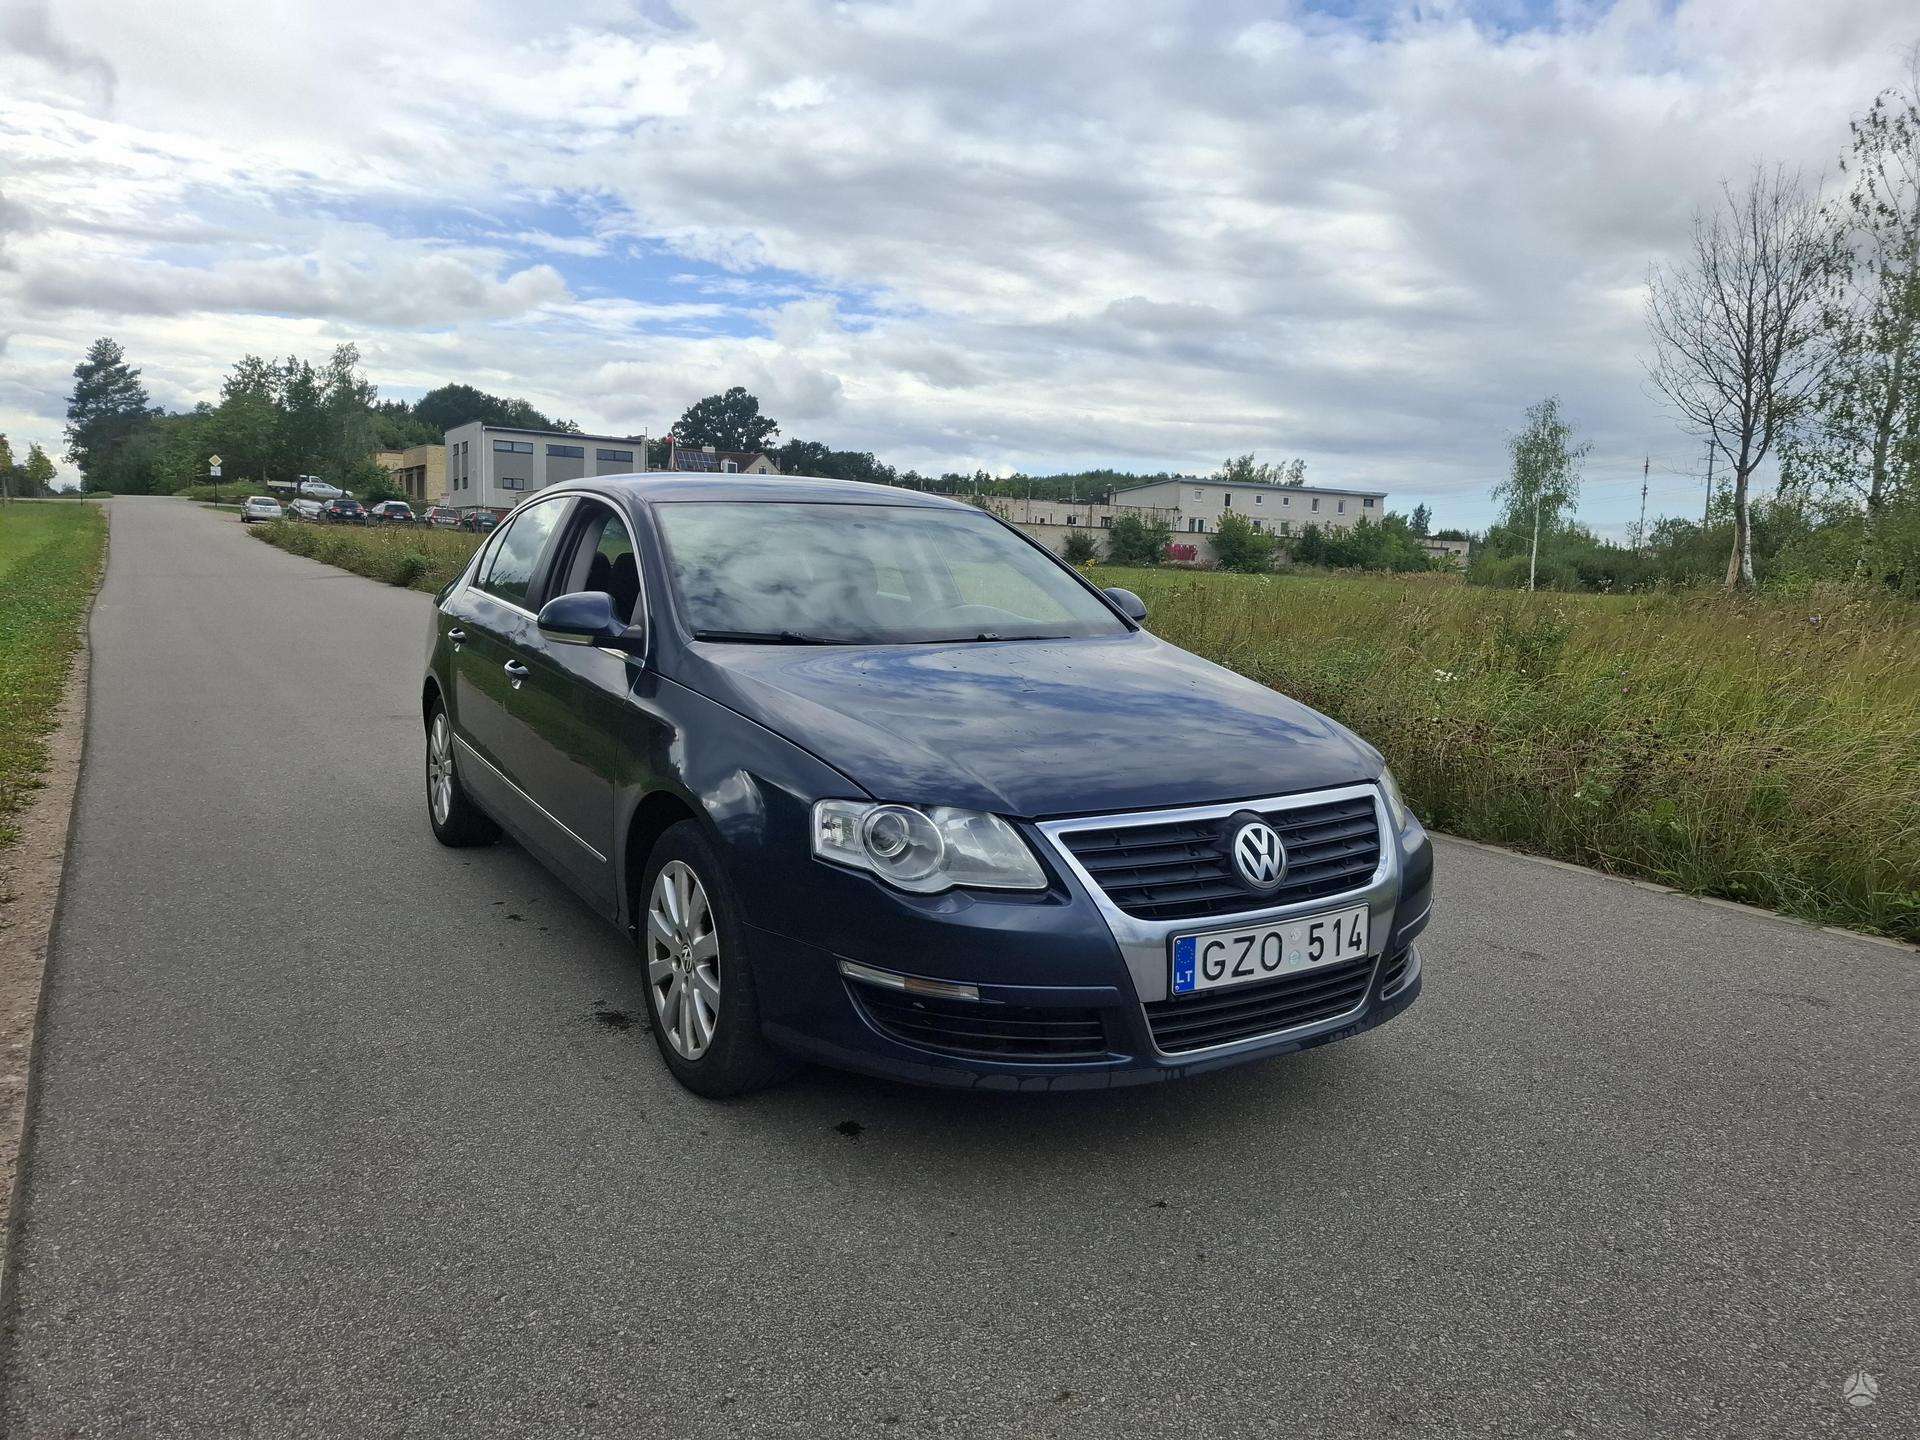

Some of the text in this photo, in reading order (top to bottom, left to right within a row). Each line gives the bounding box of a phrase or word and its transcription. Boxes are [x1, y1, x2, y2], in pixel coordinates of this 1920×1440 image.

[1236, 823, 1285, 886] VW
[1176, 970, 1193, 984] LT
[1202, 913, 1362, 981] GZO 514
